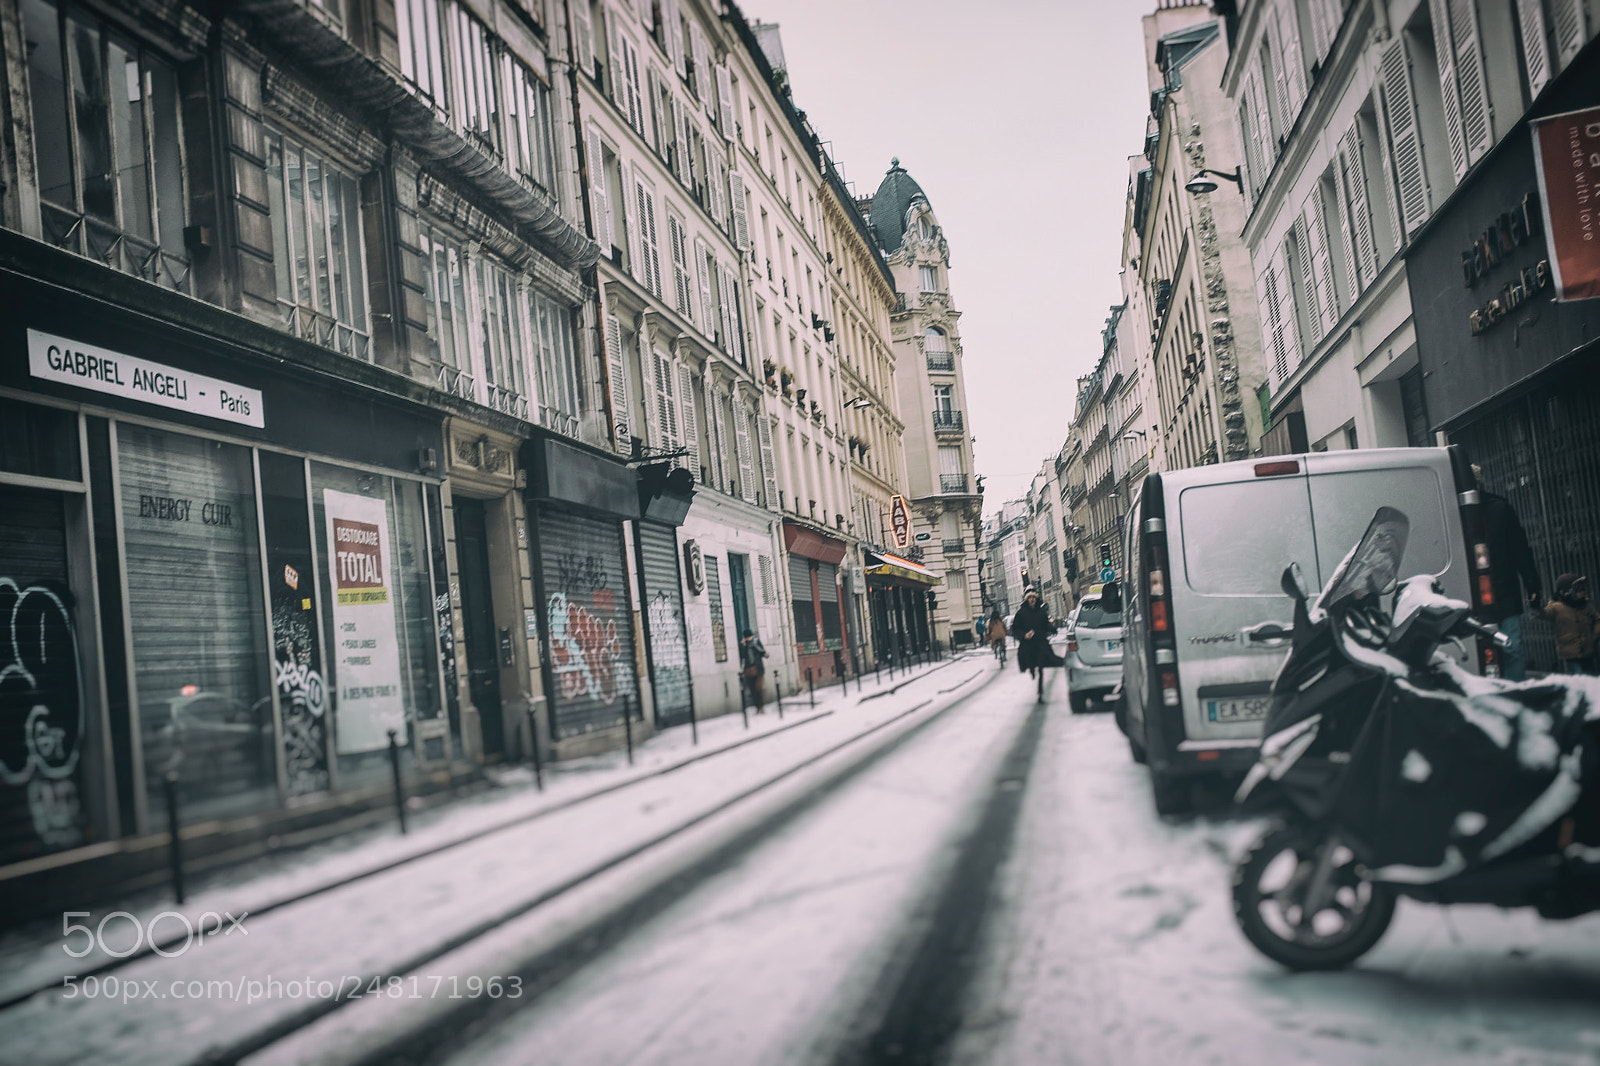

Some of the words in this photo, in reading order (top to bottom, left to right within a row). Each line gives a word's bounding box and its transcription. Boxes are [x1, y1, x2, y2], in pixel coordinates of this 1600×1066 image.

[1569, 126, 1584, 168] made
[1575, 171, 1592, 204] with
[1580, 207, 1594, 241] love
[47, 345, 125, 386] GABRIEL
[132, 367, 187, 401] ANGELI
[220, 390, 251, 416] Paris
[139, 494, 192, 521] ENERGY
[201, 502, 232, 526] CUIR
[893, 498, 906, 545] TABAC
[336, 526, 379, 546] DESTOCKAGE
[337, 551, 382, 584] TOTAL
